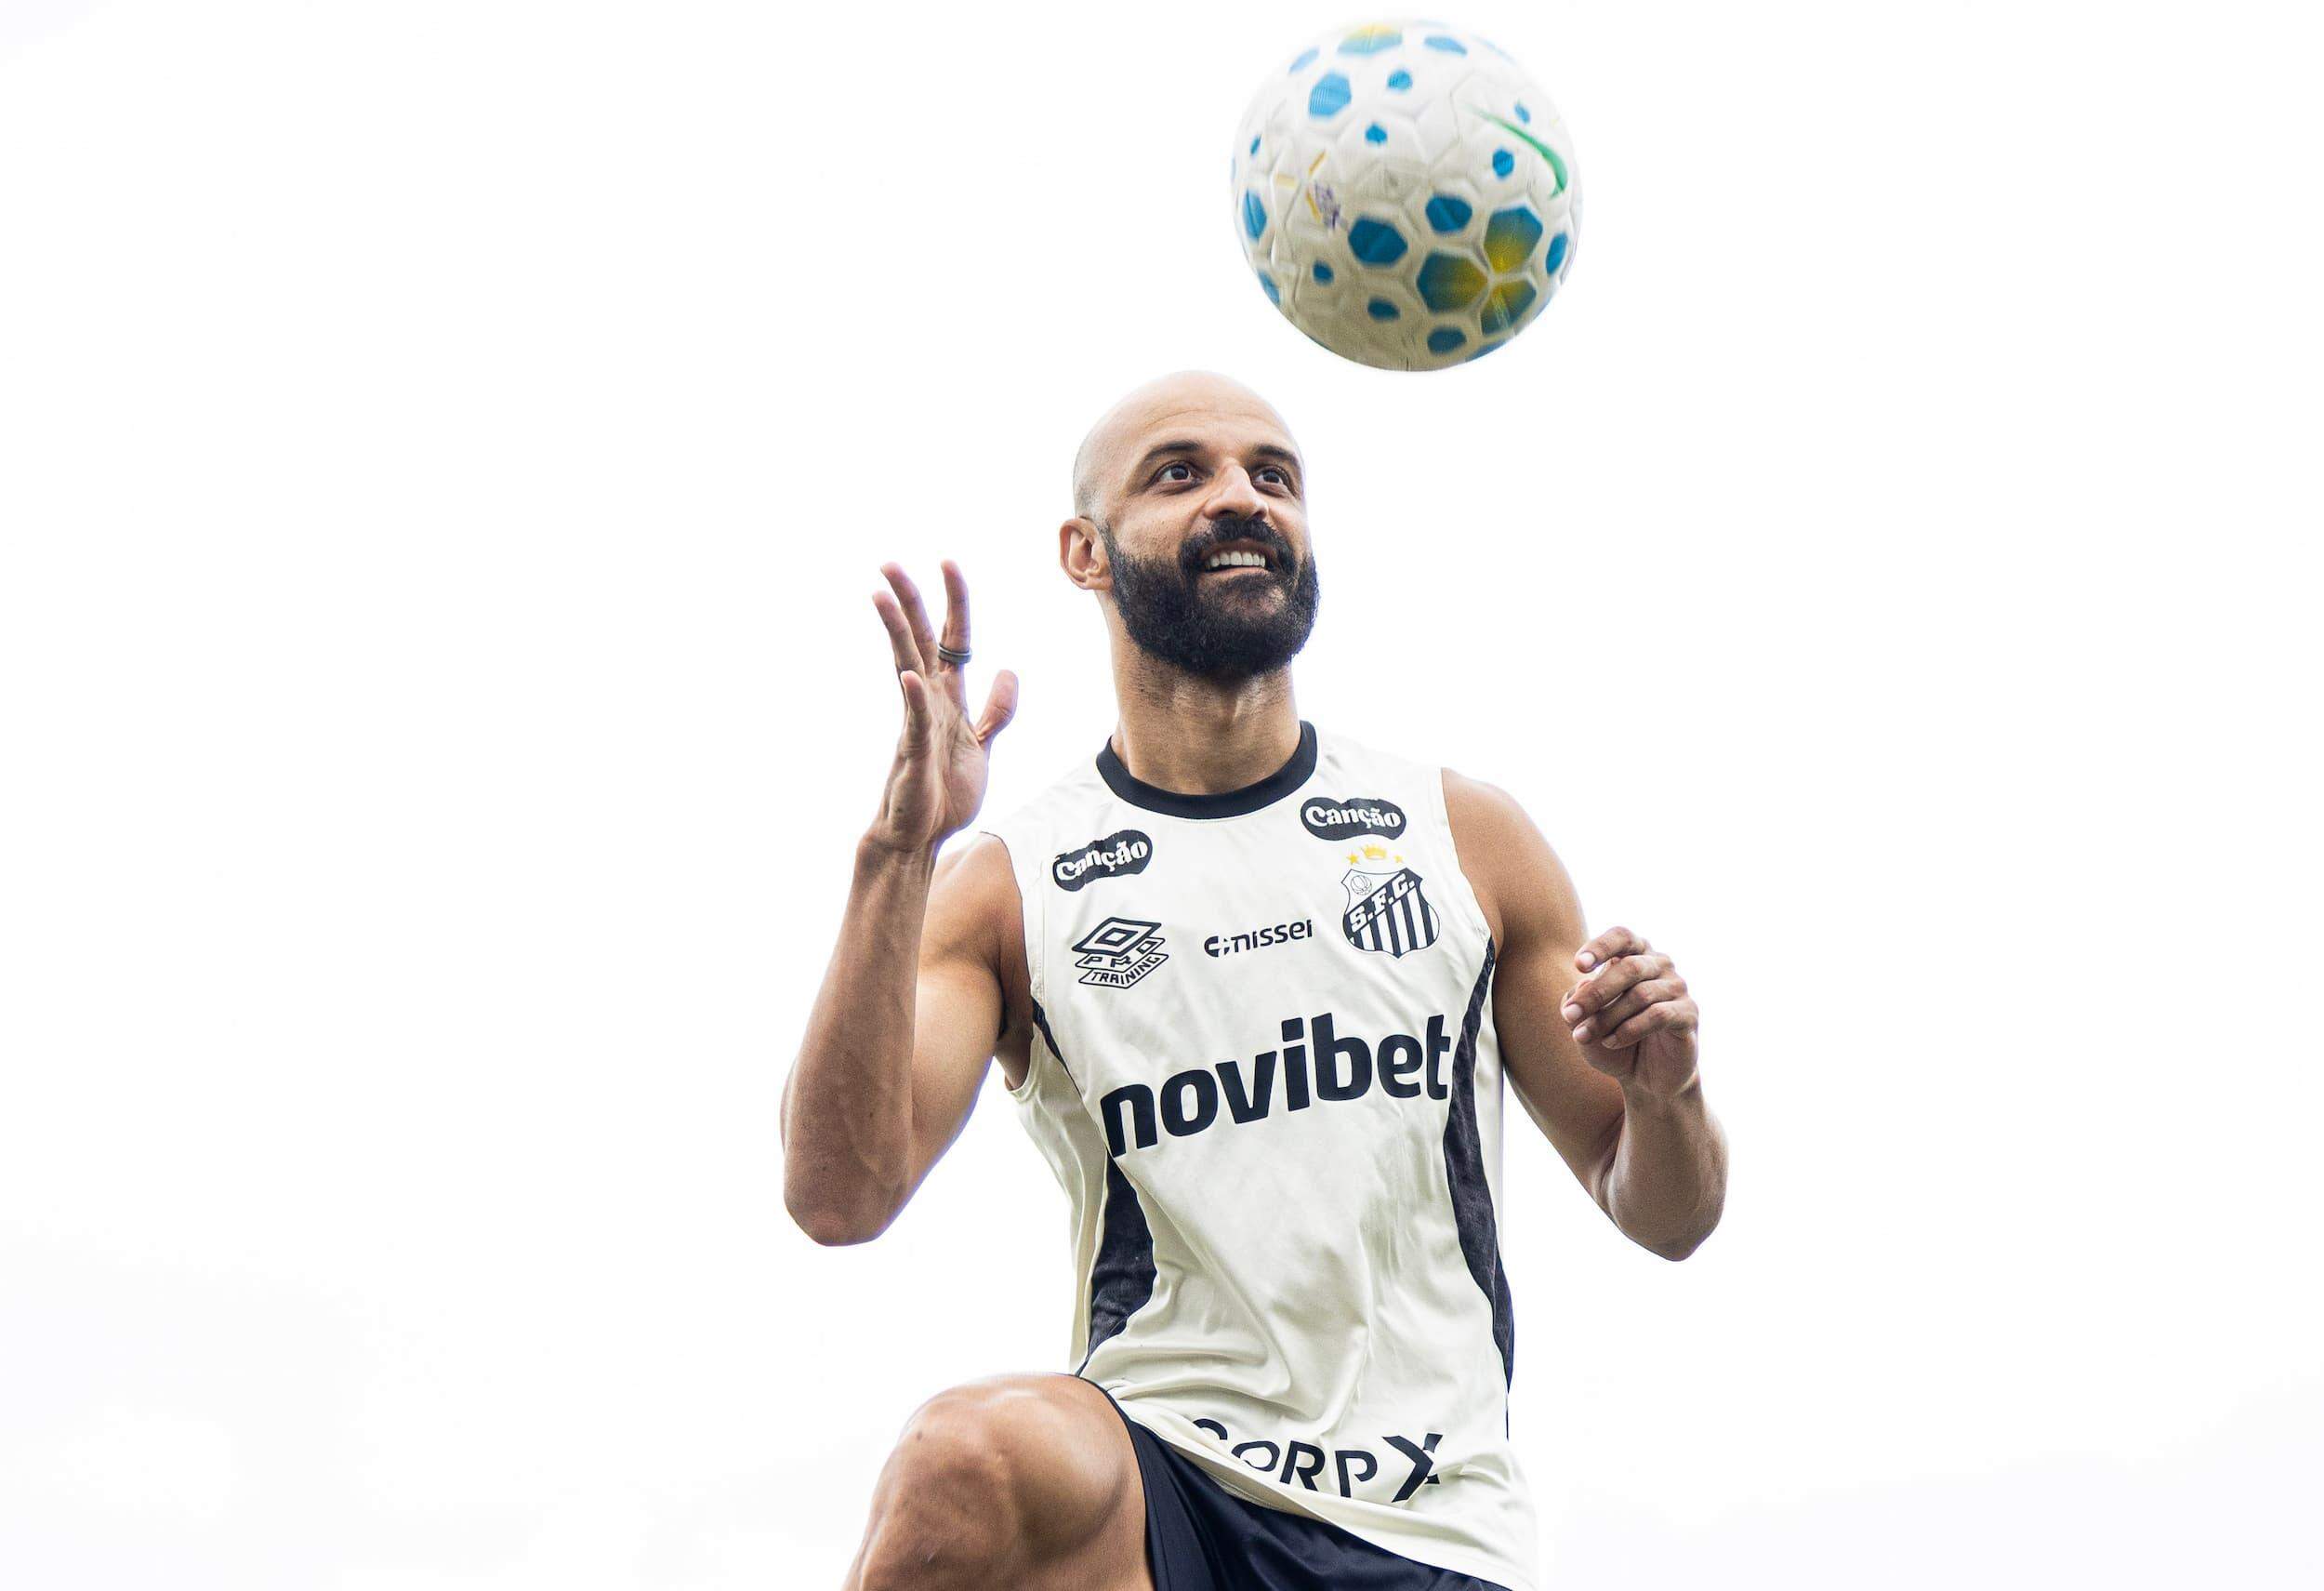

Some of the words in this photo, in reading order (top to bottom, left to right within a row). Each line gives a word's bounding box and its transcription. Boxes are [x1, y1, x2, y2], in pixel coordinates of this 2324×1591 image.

[1305, 806, 1401, 829] Canção
[1056, 841, 1148, 881] Canção
[1349, 873, 1415, 933] S.F.C.
[1083, 940, 1159, 968] PRO
[1091, 956, 1161, 985] TRAINING
[1100, 1012, 1452, 1159] novibet
